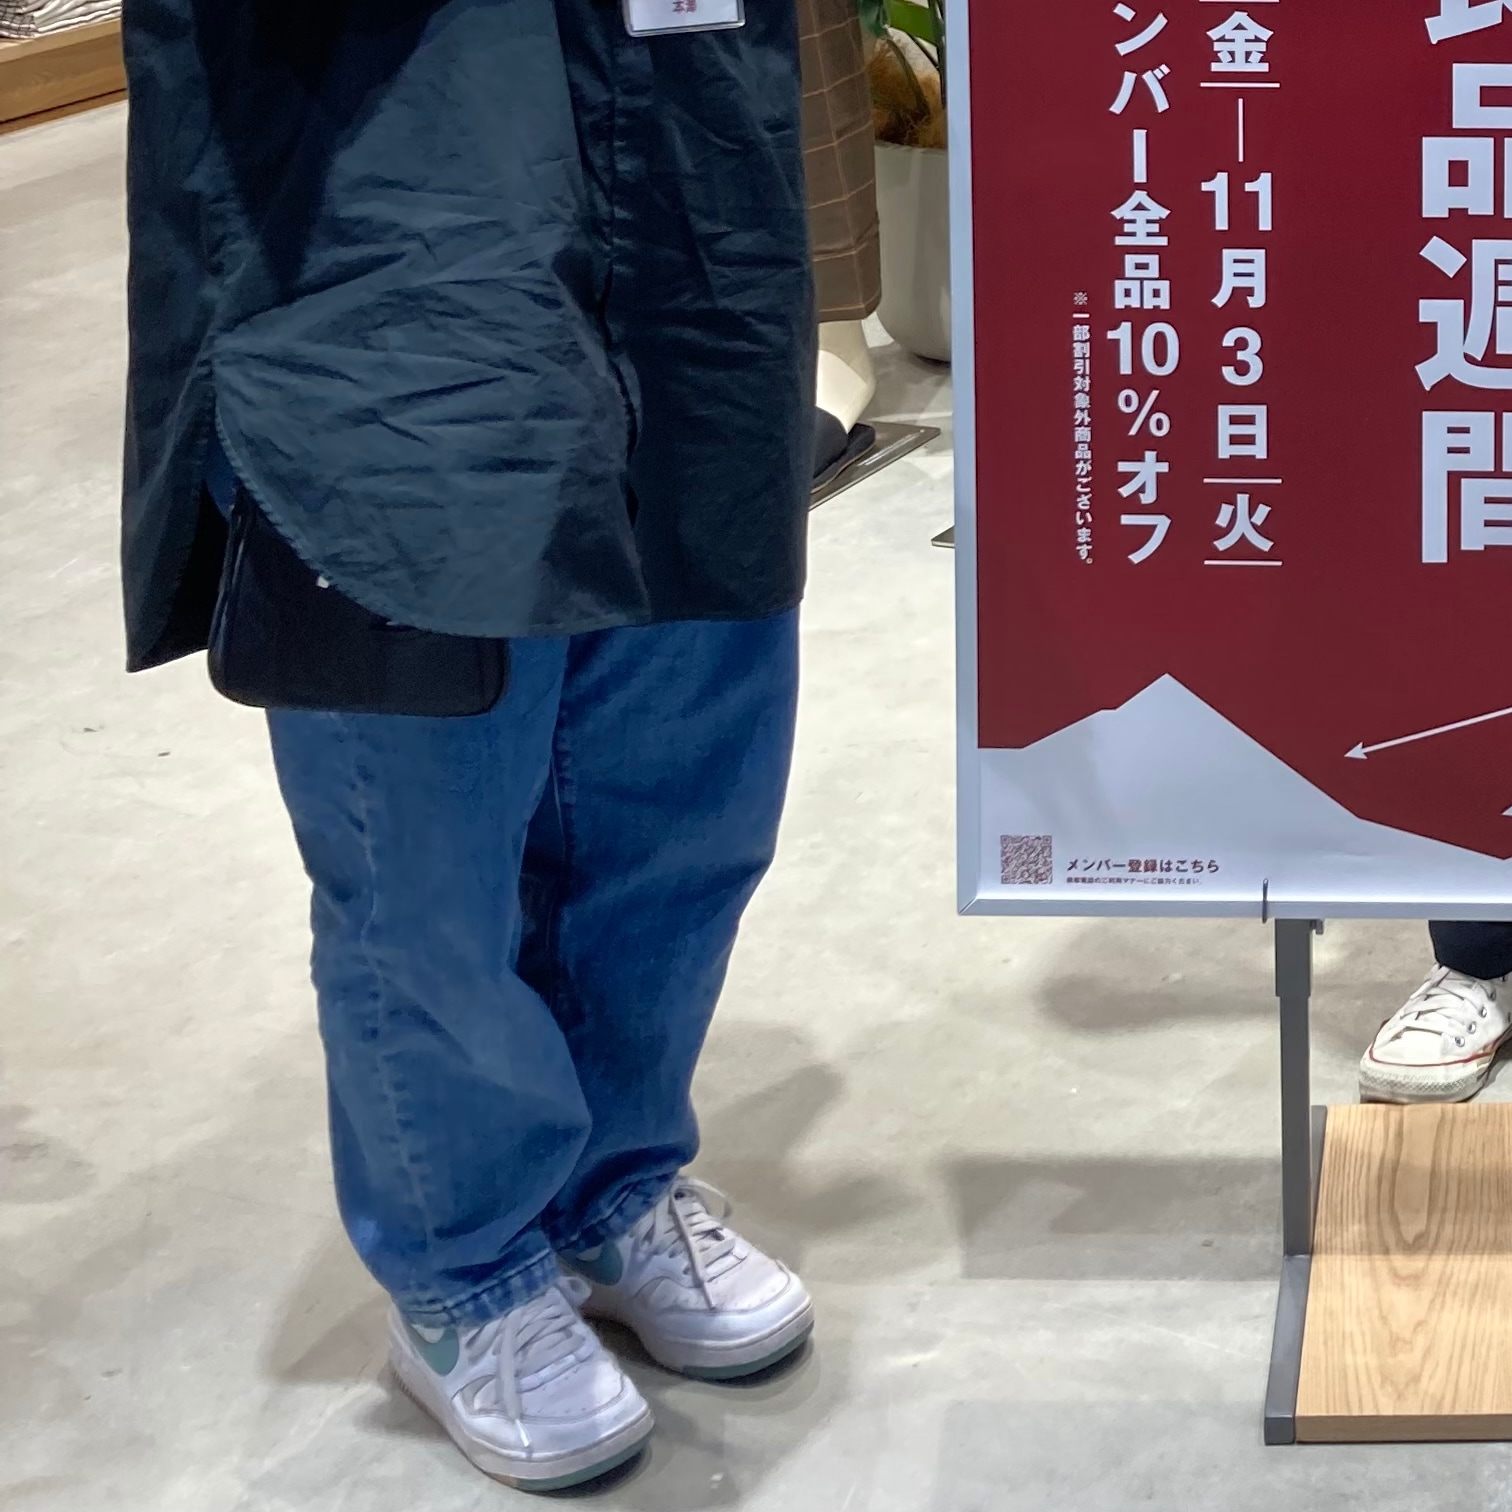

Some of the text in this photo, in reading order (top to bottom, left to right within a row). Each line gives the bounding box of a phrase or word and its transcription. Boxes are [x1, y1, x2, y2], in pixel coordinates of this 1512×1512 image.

[1071, 291, 1093, 565] ※一部割引対象外商品がございます。
[1066, 858, 1220, 874] メンバー登録はこちら
